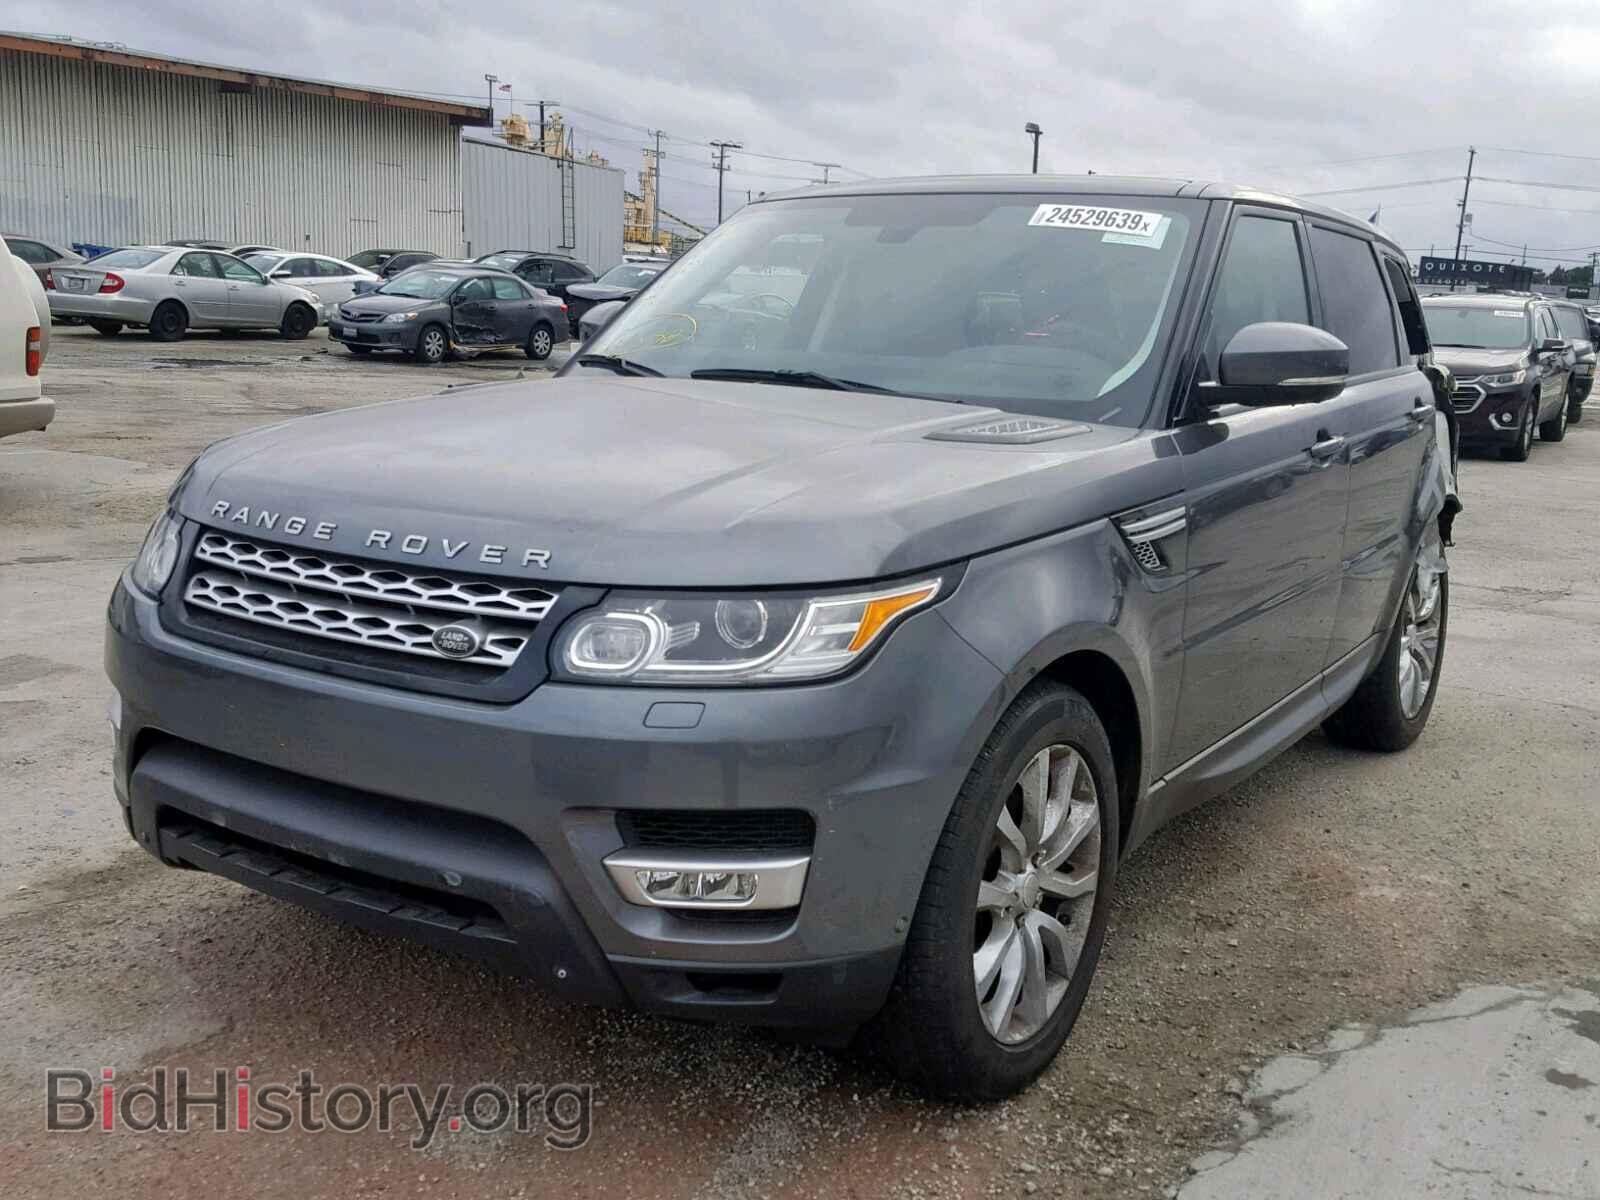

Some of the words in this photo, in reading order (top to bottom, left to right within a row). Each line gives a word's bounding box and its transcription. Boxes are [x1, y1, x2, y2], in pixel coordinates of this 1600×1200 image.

[1425, 262, 1506, 273] QUIXOTE
[211, 500, 337, 540] RANGE
[365, 529, 553, 569] ROVER
[441, 631, 464, 642] LAND
